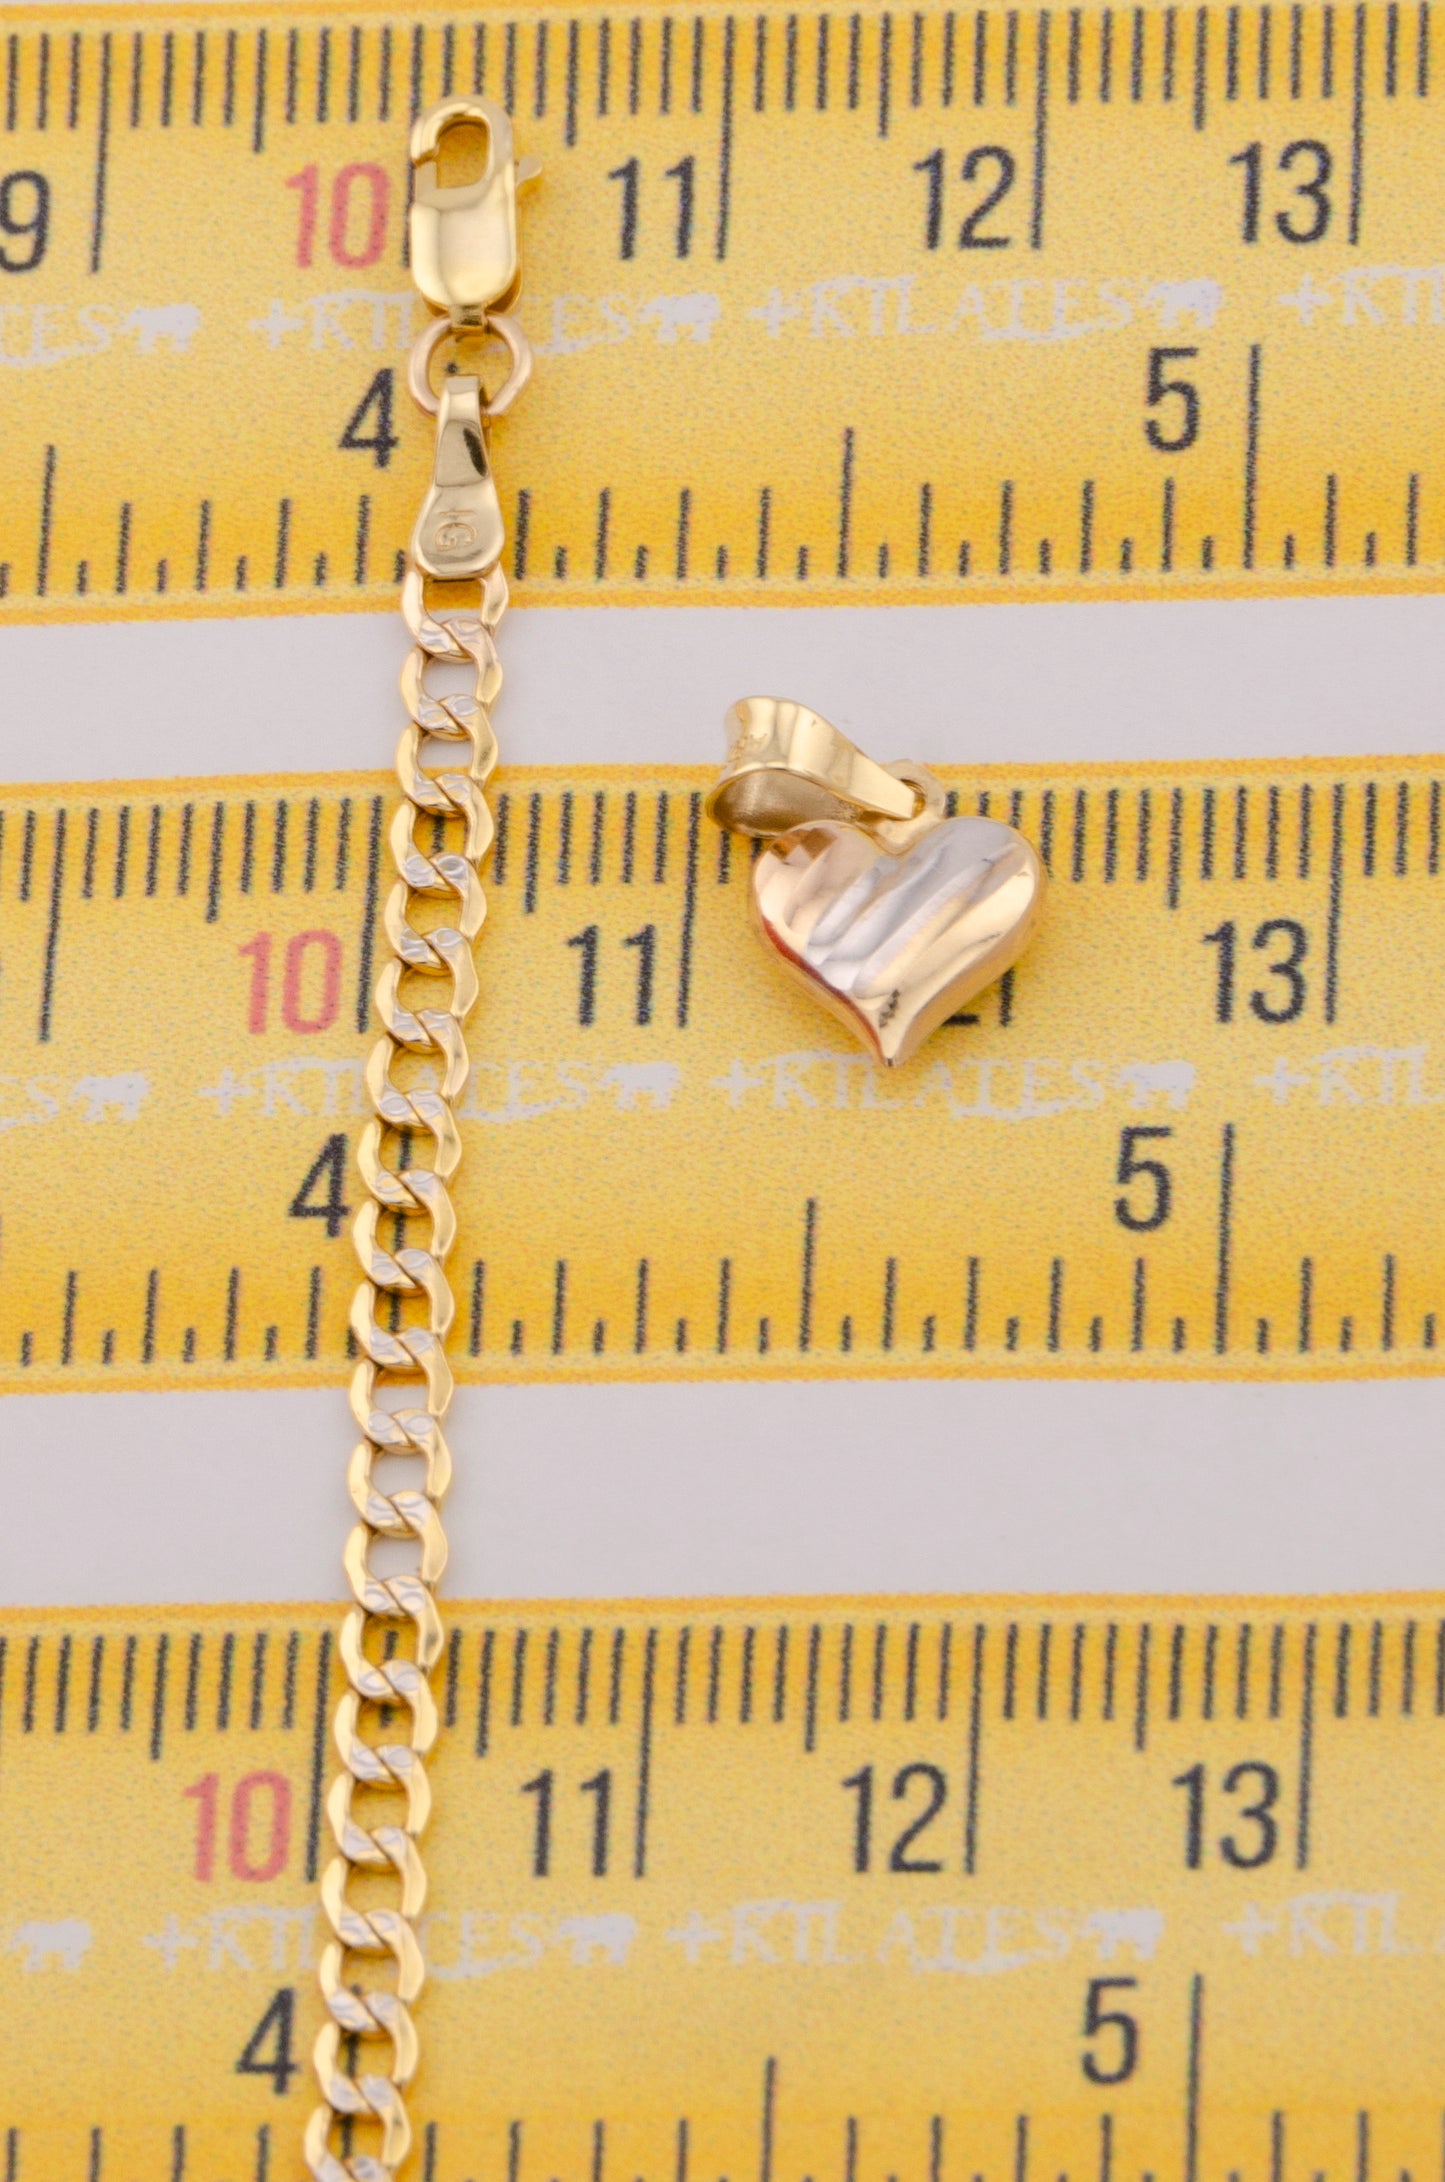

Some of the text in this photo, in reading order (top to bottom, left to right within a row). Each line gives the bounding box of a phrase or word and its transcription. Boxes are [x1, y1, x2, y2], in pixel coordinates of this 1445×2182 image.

[0, 170, 50, 273] 9
[286, 163, 391, 269] 10
[609, 156, 694, 261] 11
[914, 145, 1020, 250] 12
[1230, 139, 1333, 244] 13
[339, 368, 399, 469] 4
[1145, 347, 1200, 453] 5
[239, 930, 342, 1034] 10
[567, 924, 655, 1026] 11
[1204, 918, 1308, 1024] 13
[289, 1133, 350, 1238] 4
[1115, 1126, 1172, 1233] 5
[184, 1770, 291, 1882] 10
[522, 1769, 611, 1877] 11
[843, 1762, 948, 1873] 12
[1173, 1761, 1280, 1870] 13
[235, 1987, 298, 2096] 4
[1081, 1977, 1138, 2085] 5
